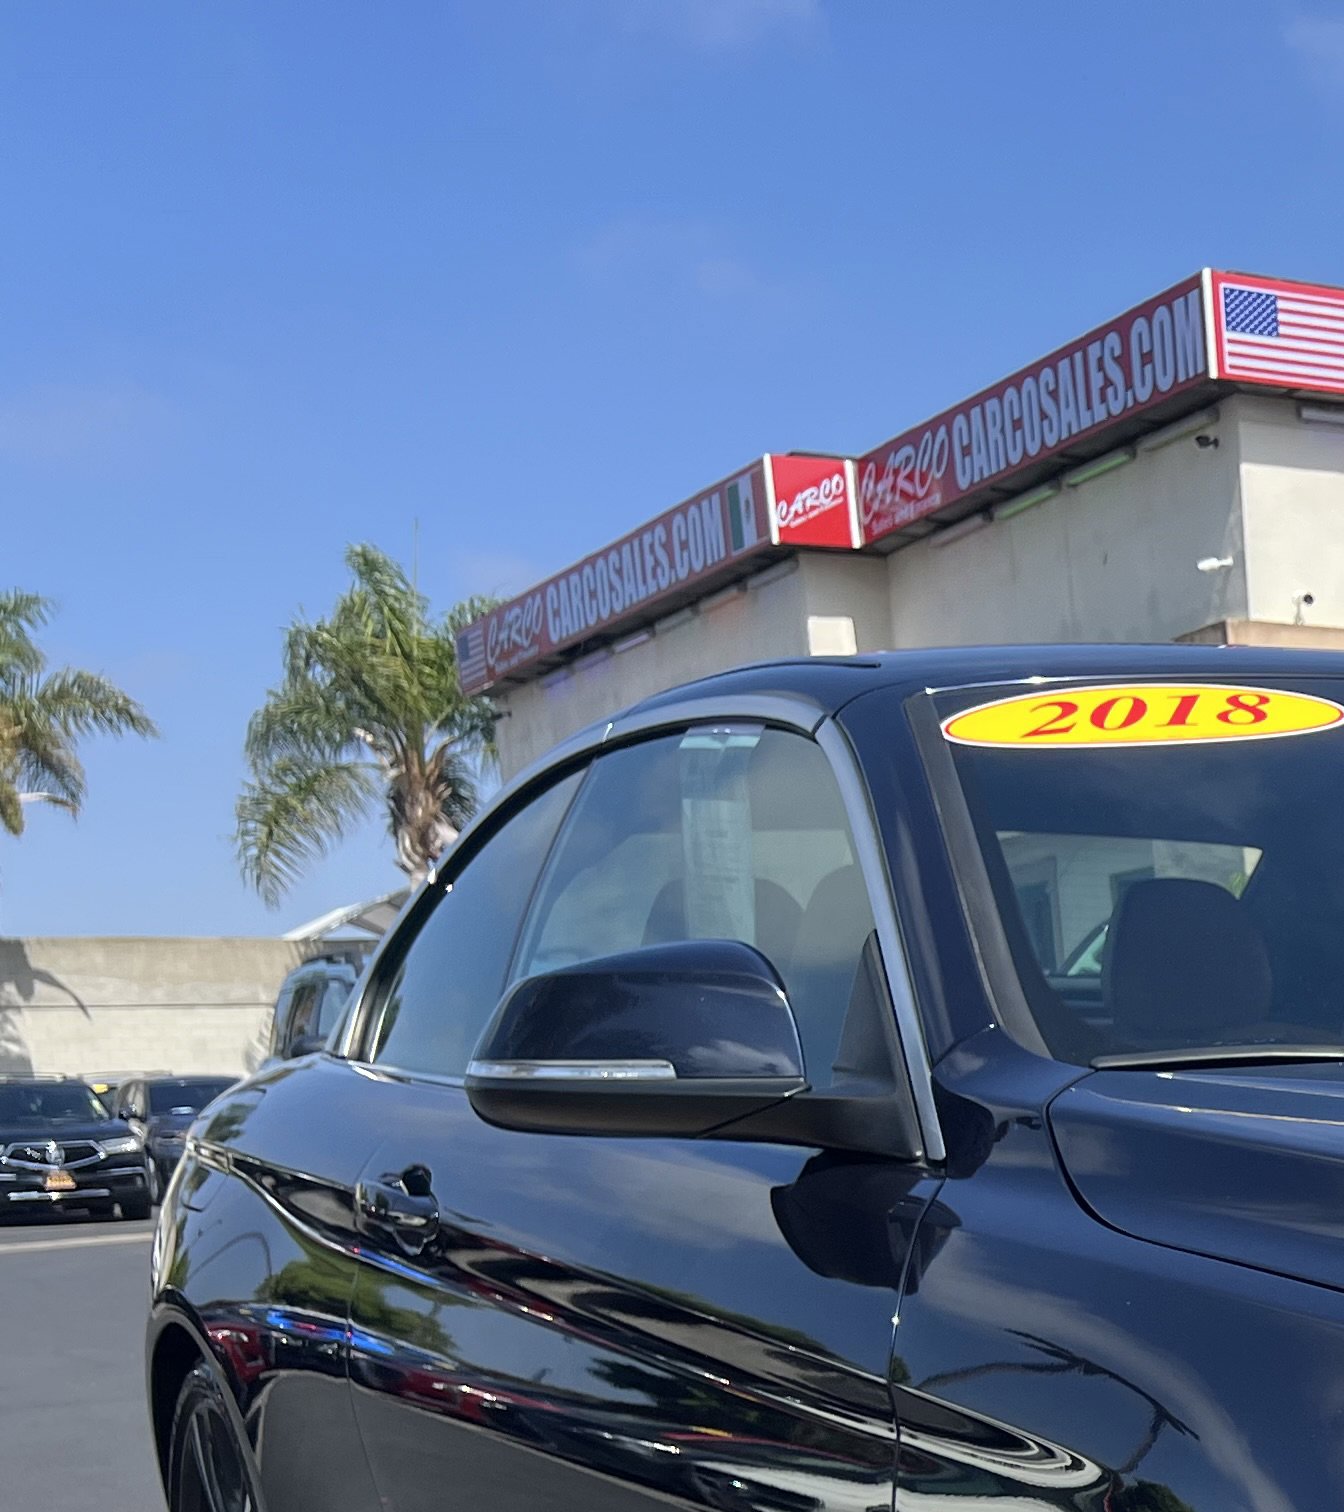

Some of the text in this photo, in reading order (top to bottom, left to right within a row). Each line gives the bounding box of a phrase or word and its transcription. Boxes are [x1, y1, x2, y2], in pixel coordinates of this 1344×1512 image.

[951, 288, 1205, 491] CARCOSALES.COM
[777, 473, 844, 528] CARCO
[860, 423, 949, 525] CARCO
[546, 491, 726, 645] CARCOSALES.COM
[1020, 693, 1271, 738] 2018
